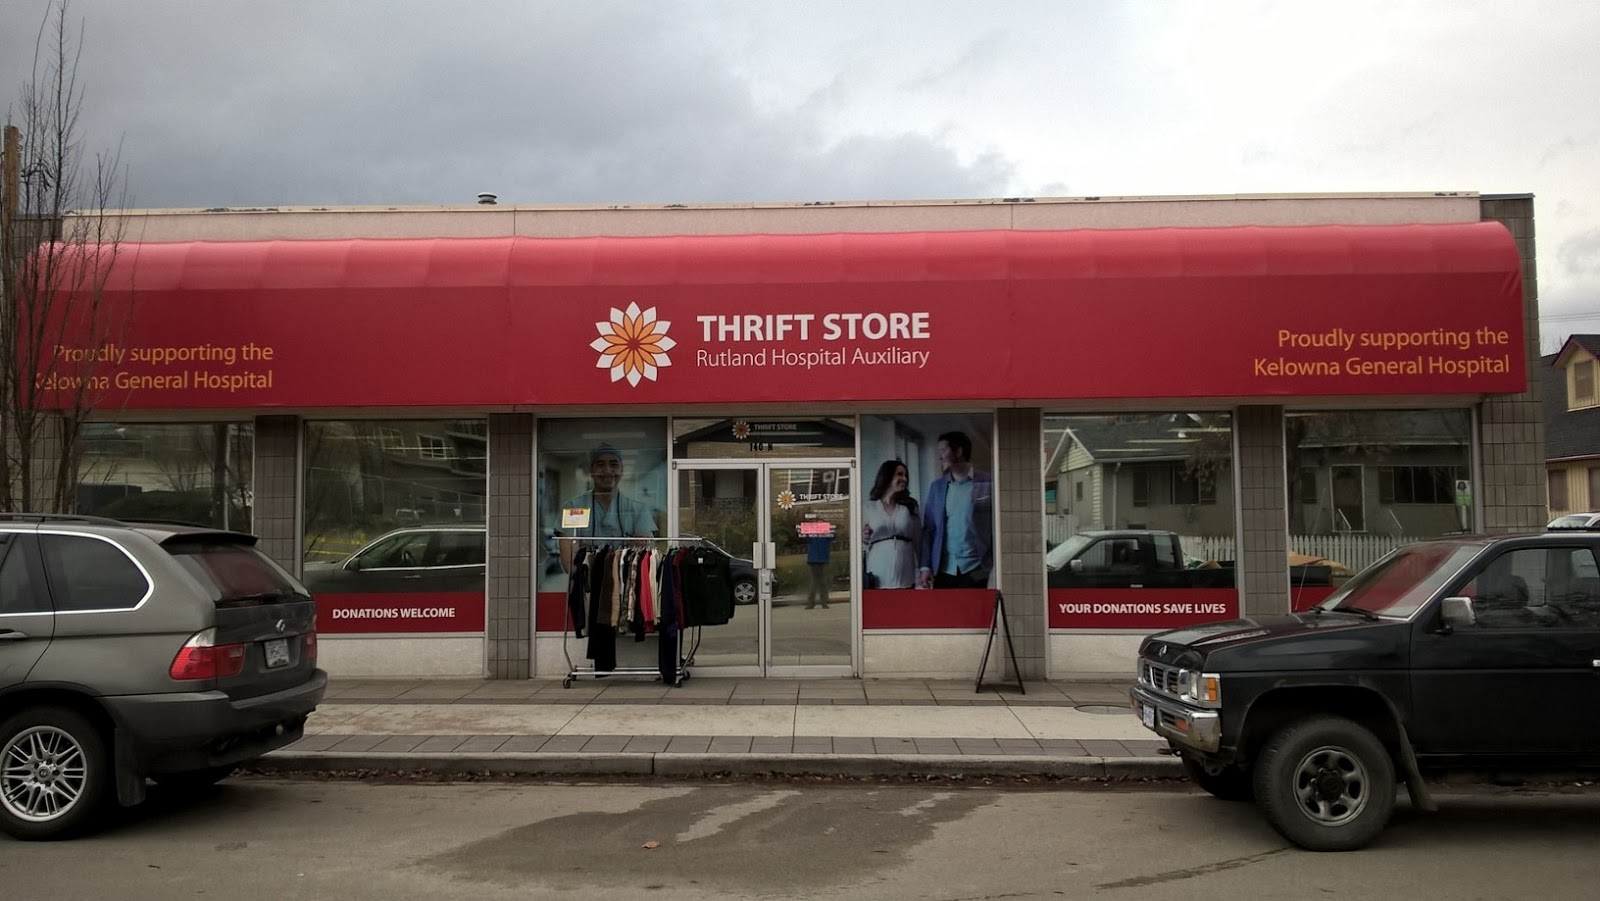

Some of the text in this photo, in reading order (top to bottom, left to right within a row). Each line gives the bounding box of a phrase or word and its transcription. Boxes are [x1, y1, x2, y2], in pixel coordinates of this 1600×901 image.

[696, 312, 931, 342] THRIFT STORE
[1278, 326, 1509, 351] Proudly supporting the
[53, 342, 274, 365] Proudly supporting the
[697, 346, 930, 370] Rutland Hospital Auxiliary
[1254, 354, 1510, 378] Kelowna General Hospital
[115, 371, 188, 389] General
[194, 370, 273, 393] Hospital
[754, 423, 776, 431] THRIFT
[332, 607, 456, 619] DONATIONS WELCOME
[1059, 603, 1227, 614] YOUR DONATIONS SAVE LIVES
